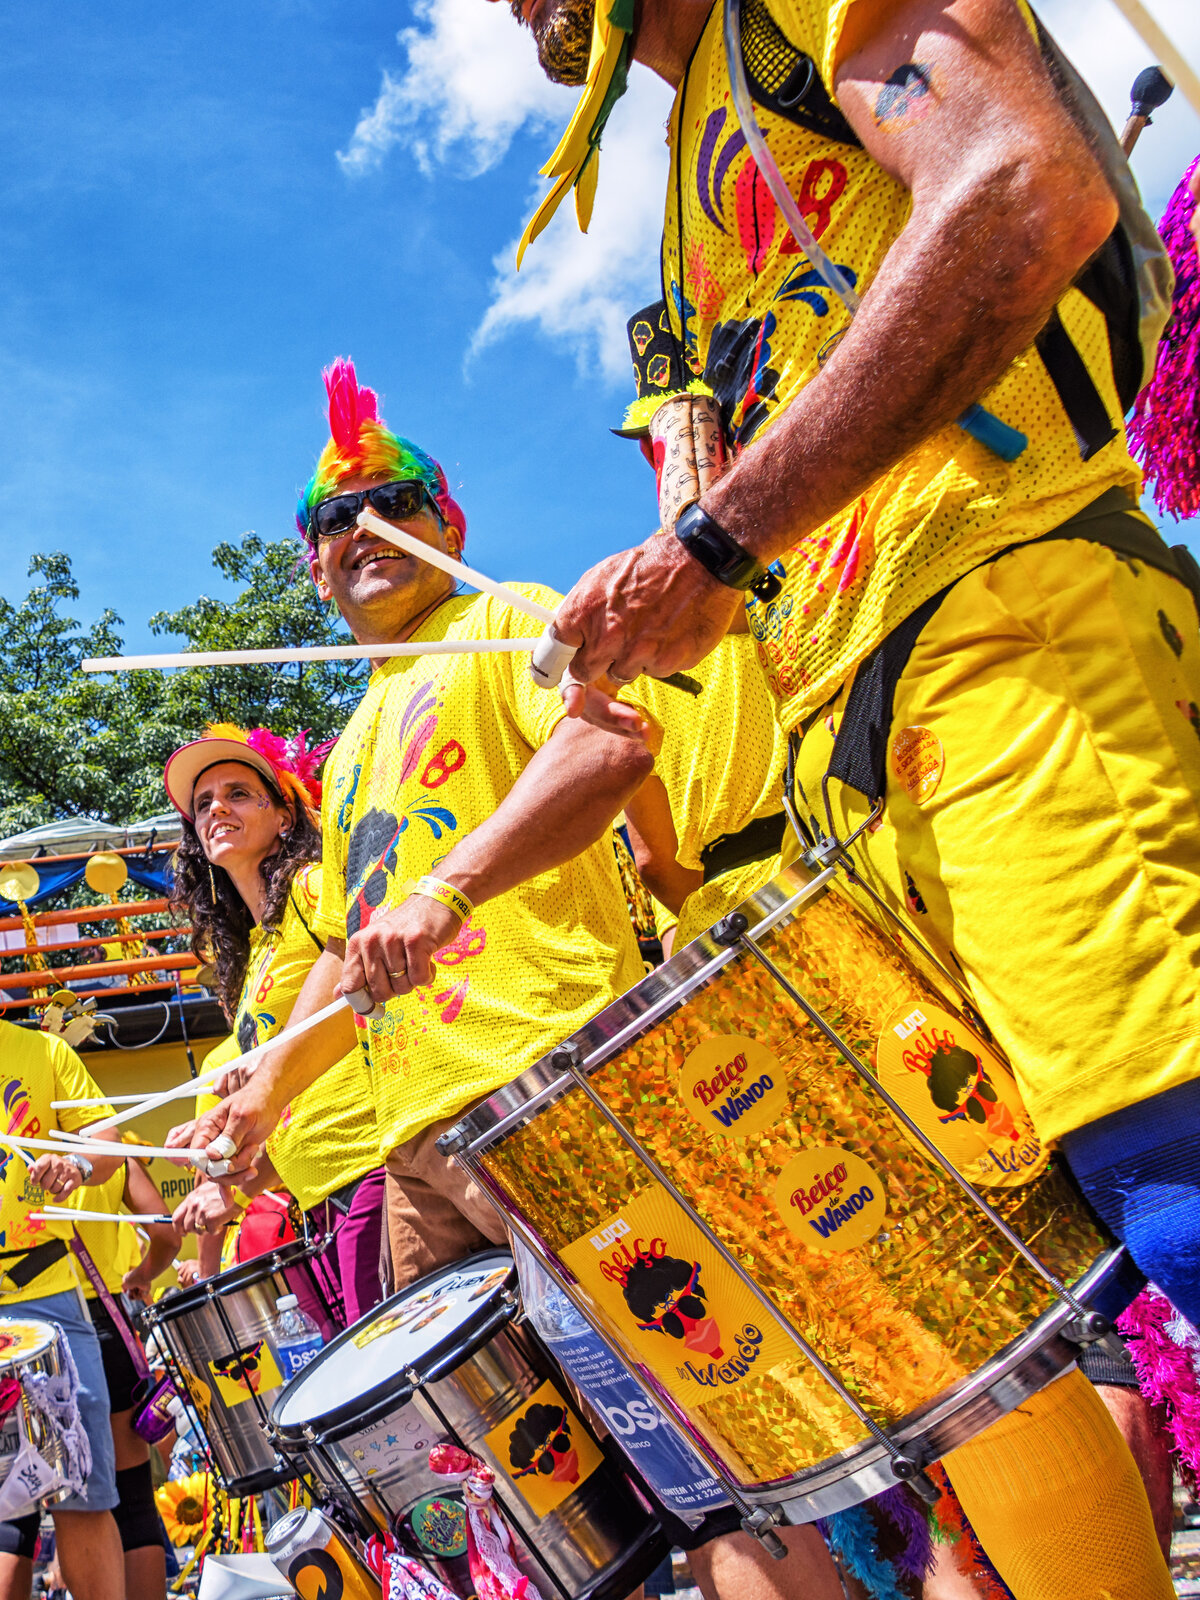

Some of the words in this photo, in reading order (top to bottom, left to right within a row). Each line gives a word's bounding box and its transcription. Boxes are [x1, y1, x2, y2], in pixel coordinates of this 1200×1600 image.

[896, 766, 903, 775] E
[902, 1025, 957, 1077] Beiço
[693, 1052, 748, 1107] Beiço
[711, 1074, 774, 1128] WANDO
[161, 1177, 195, 1199] APOI
[790, 1162, 848, 1217] Beiço
[808, 1185, 875, 1239] WANDO
[599, 1237, 668, 1288] Beiço
[566, 1356, 589, 1368] precisa
[589, 1350, 606, 1360] suar
[576, 1345, 590, 1355] não
[684, 1323, 763, 1388] Wando
[577, 1362, 600, 1373] camisa
[600, 1358, 614, 1368] pra
[578, 1367, 616, 1381] administrar
[589, 1381, 601, 1389] seu
[625, 1440, 652, 1450] Banco
[687, 1484, 694, 1493] 1
[693, 1477, 717, 1491] UNID
